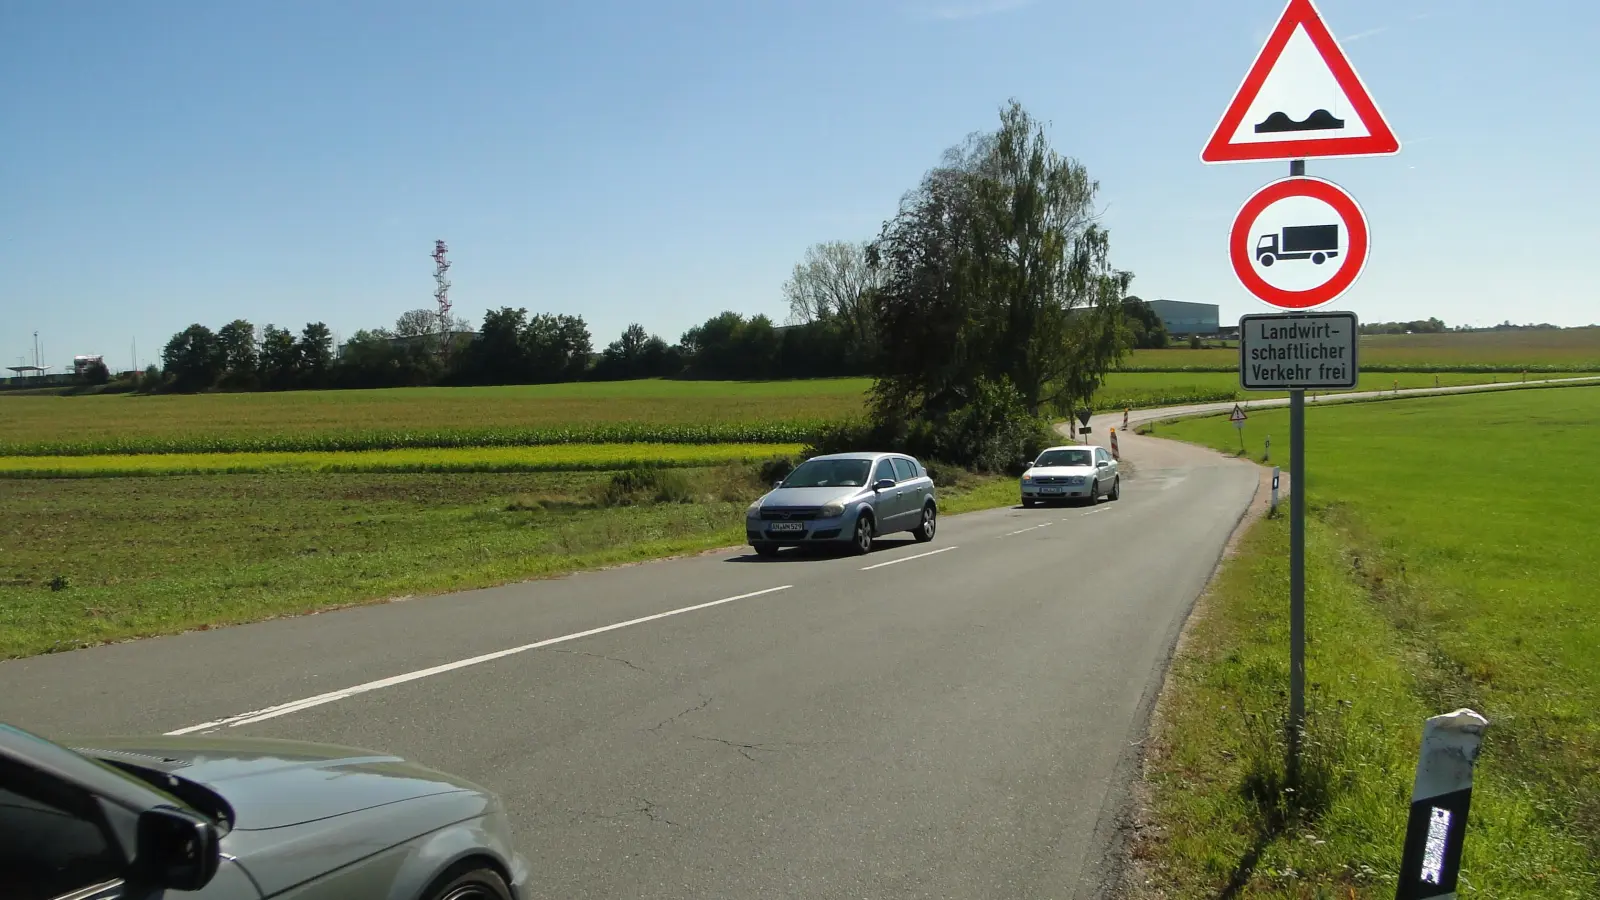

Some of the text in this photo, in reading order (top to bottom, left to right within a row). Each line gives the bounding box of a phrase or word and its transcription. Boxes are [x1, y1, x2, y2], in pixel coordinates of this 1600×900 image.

[1261, 322, 1340, 340] Landwirt-
[1251, 343, 1345, 360] schaftlicher
[1252, 363, 1346, 381] Verkehr frei
